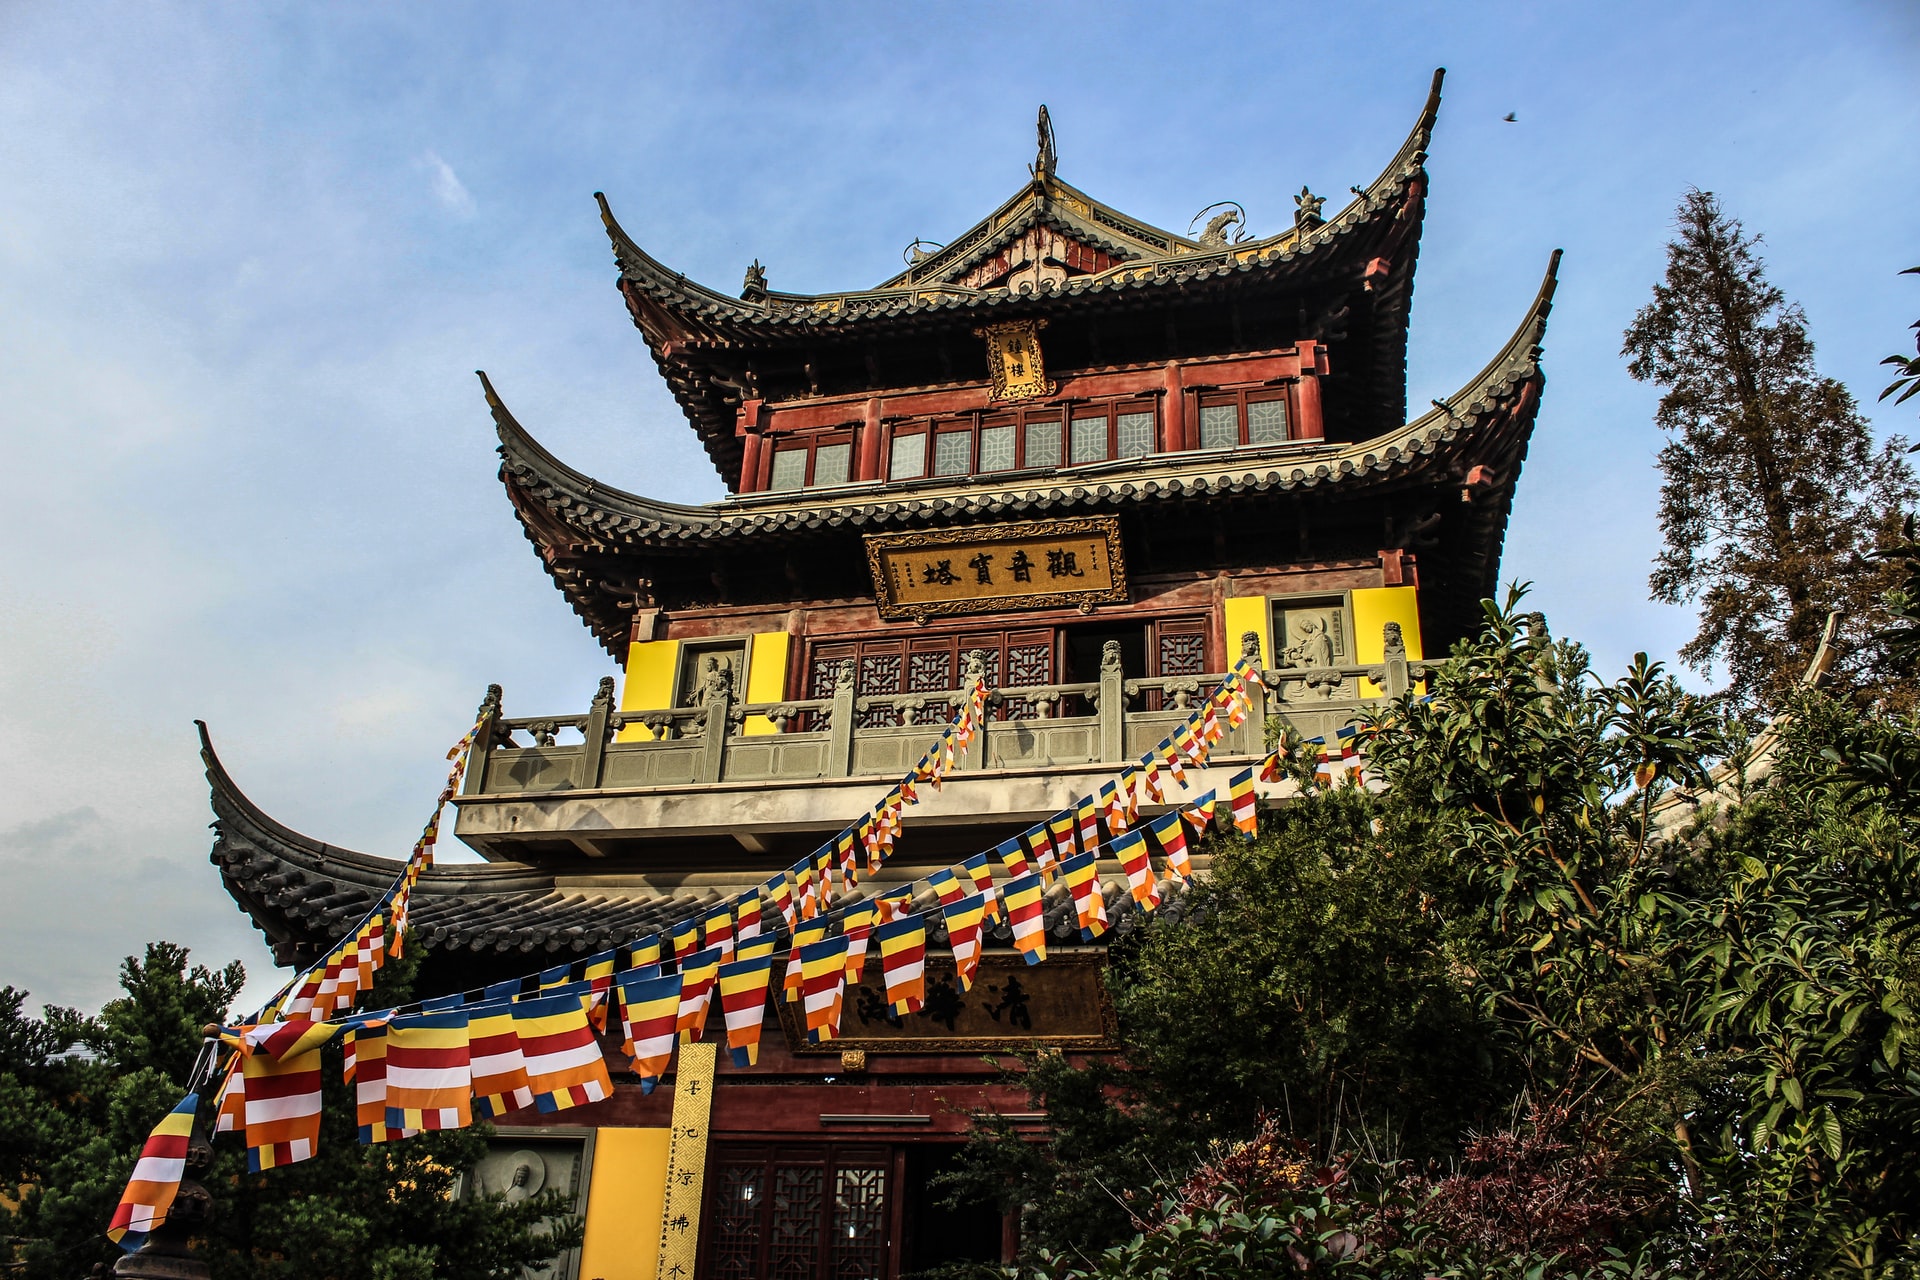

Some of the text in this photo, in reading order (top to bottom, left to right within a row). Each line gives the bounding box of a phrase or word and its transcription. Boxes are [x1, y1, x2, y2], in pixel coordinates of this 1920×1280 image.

[1007, 338, 1026, 378] 鐘樓
[922, 548, 1084, 586] 觀音寶塔
